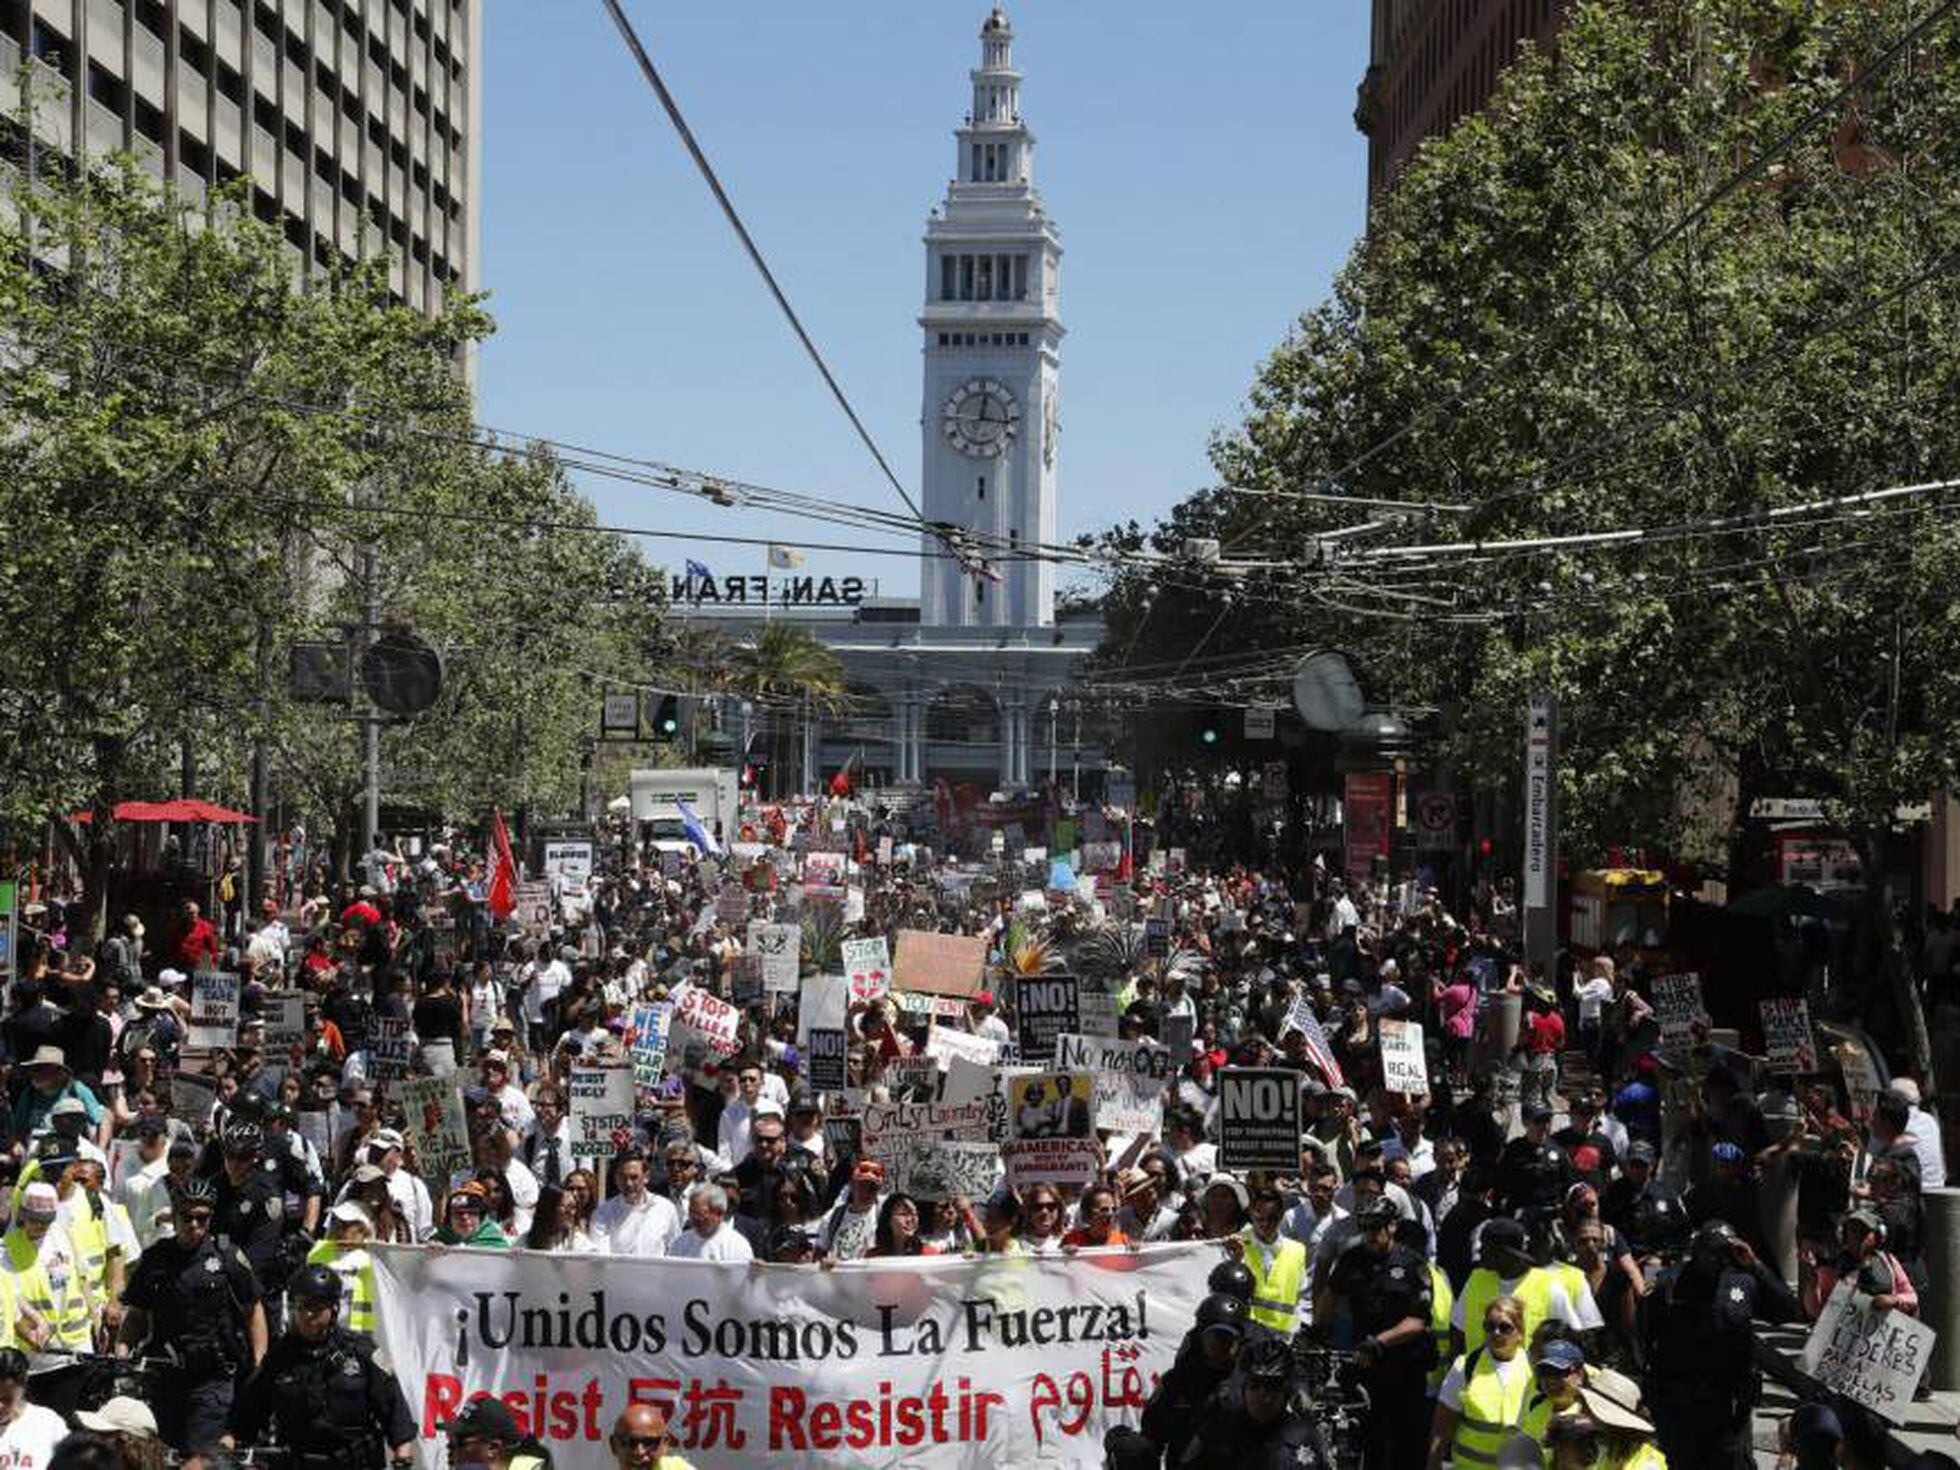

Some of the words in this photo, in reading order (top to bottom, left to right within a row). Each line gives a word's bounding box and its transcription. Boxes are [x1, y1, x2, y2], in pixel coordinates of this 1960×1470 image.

[1531, 775, 1545, 873] Embarcadero
[682, 989, 730, 1019] STOP
[1020, 982, 1076, 1012] ¡NO!
[811, 1032, 844, 1056] NO!
[1060, 1035, 1092, 1066] No
[1387, 1061, 1423, 1079] REAL
[1224, 1079, 1294, 1121] NO!
[456, 1290, 665, 1366] ¡Unidos
[682, 1298, 858, 1361] Somos
[876, 1302, 945, 1357] La
[962, 1290, 1149, 1352] Fuerza!
[768, 1375, 1005, 1451] Resistir
